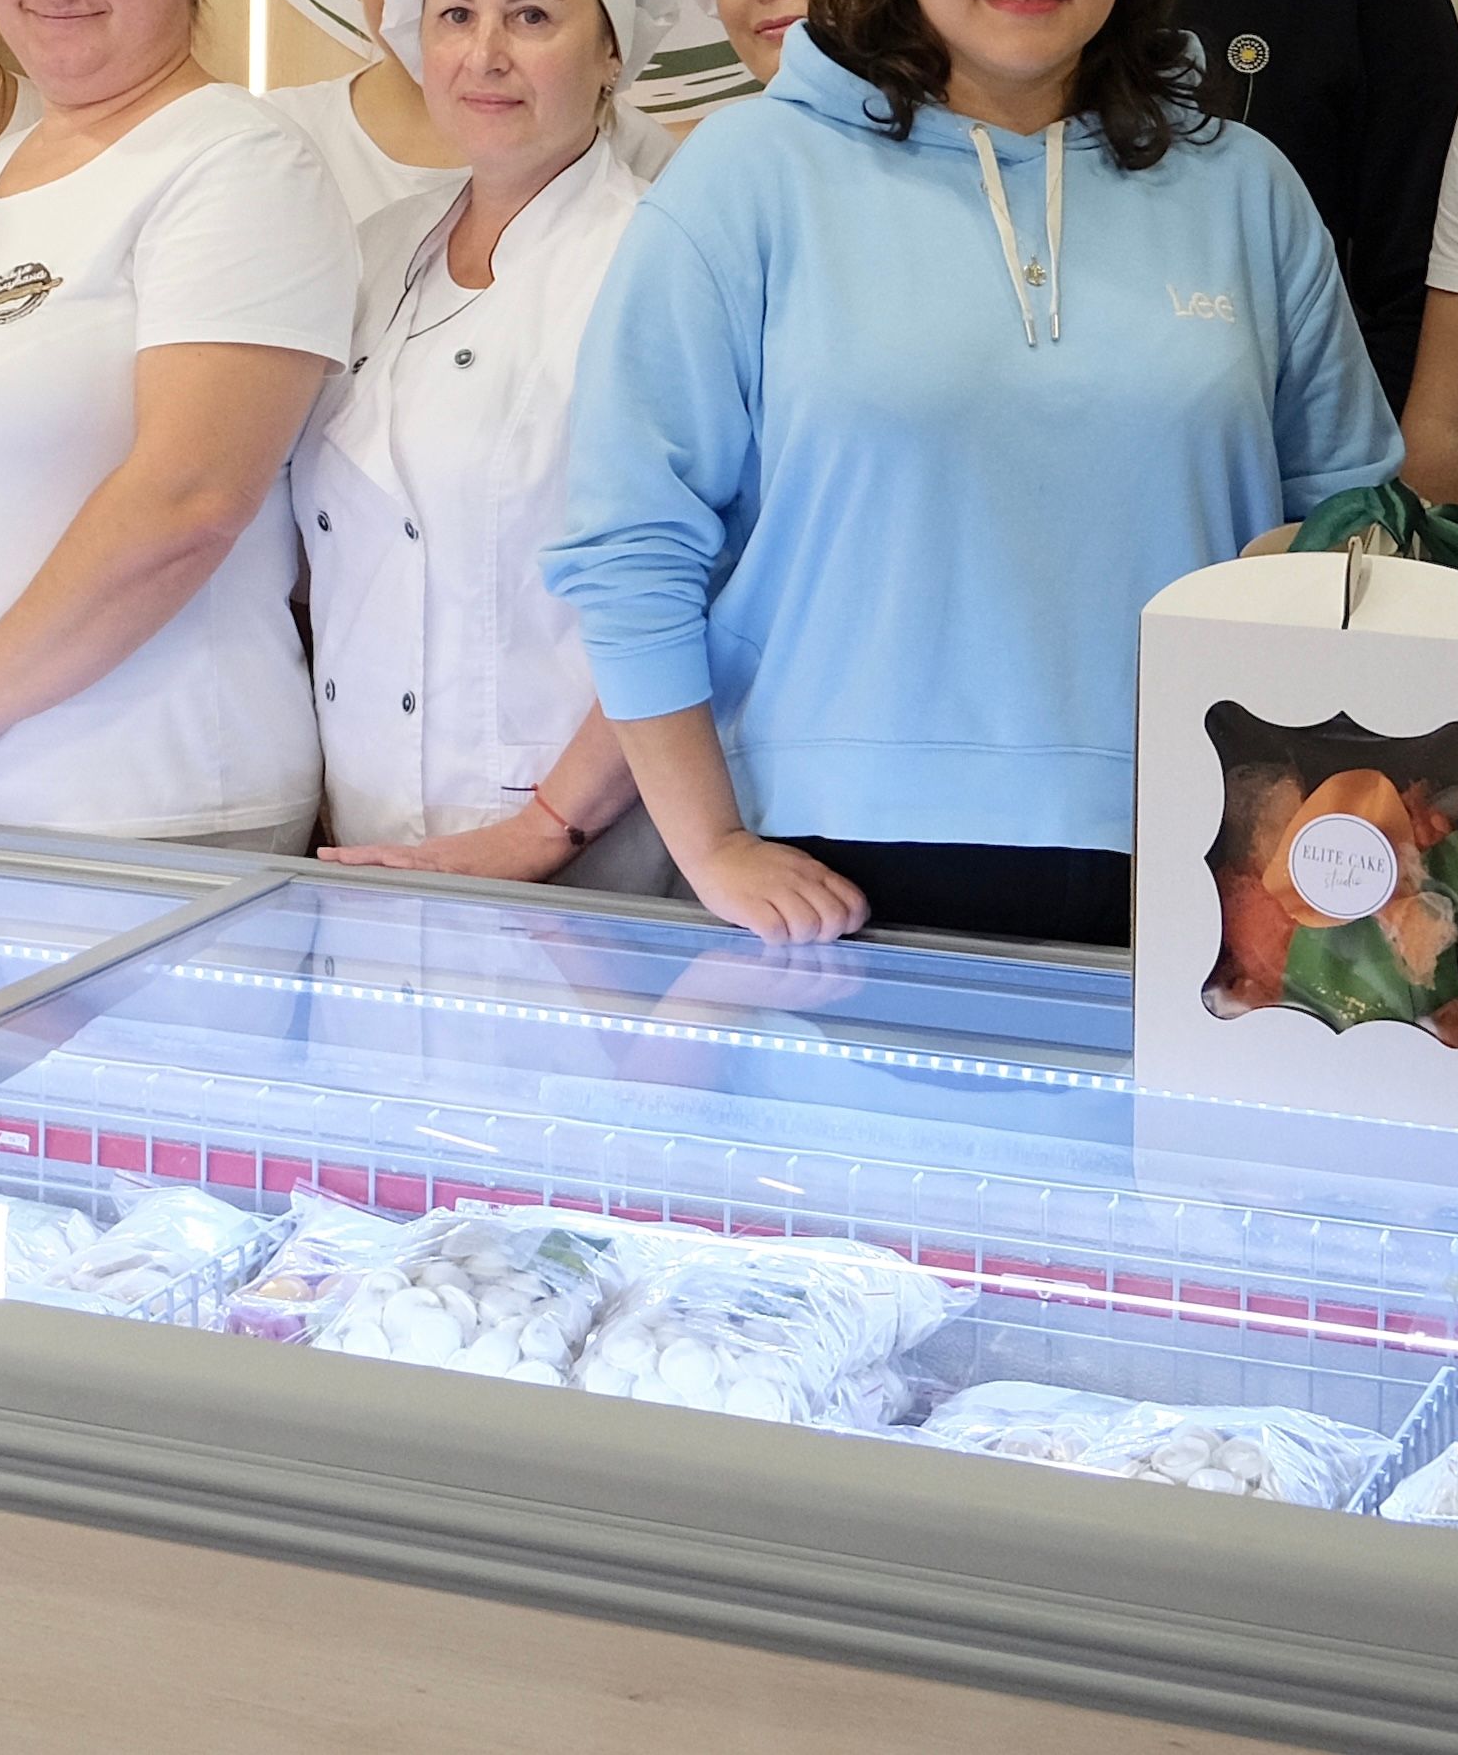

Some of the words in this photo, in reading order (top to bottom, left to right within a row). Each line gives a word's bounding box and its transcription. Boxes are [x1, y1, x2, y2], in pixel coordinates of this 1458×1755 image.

[1165, 283, 1236, 323] Lee
[1302, 844, 1344, 866] ELITE
[1348, 852, 1385, 874] CAKE
